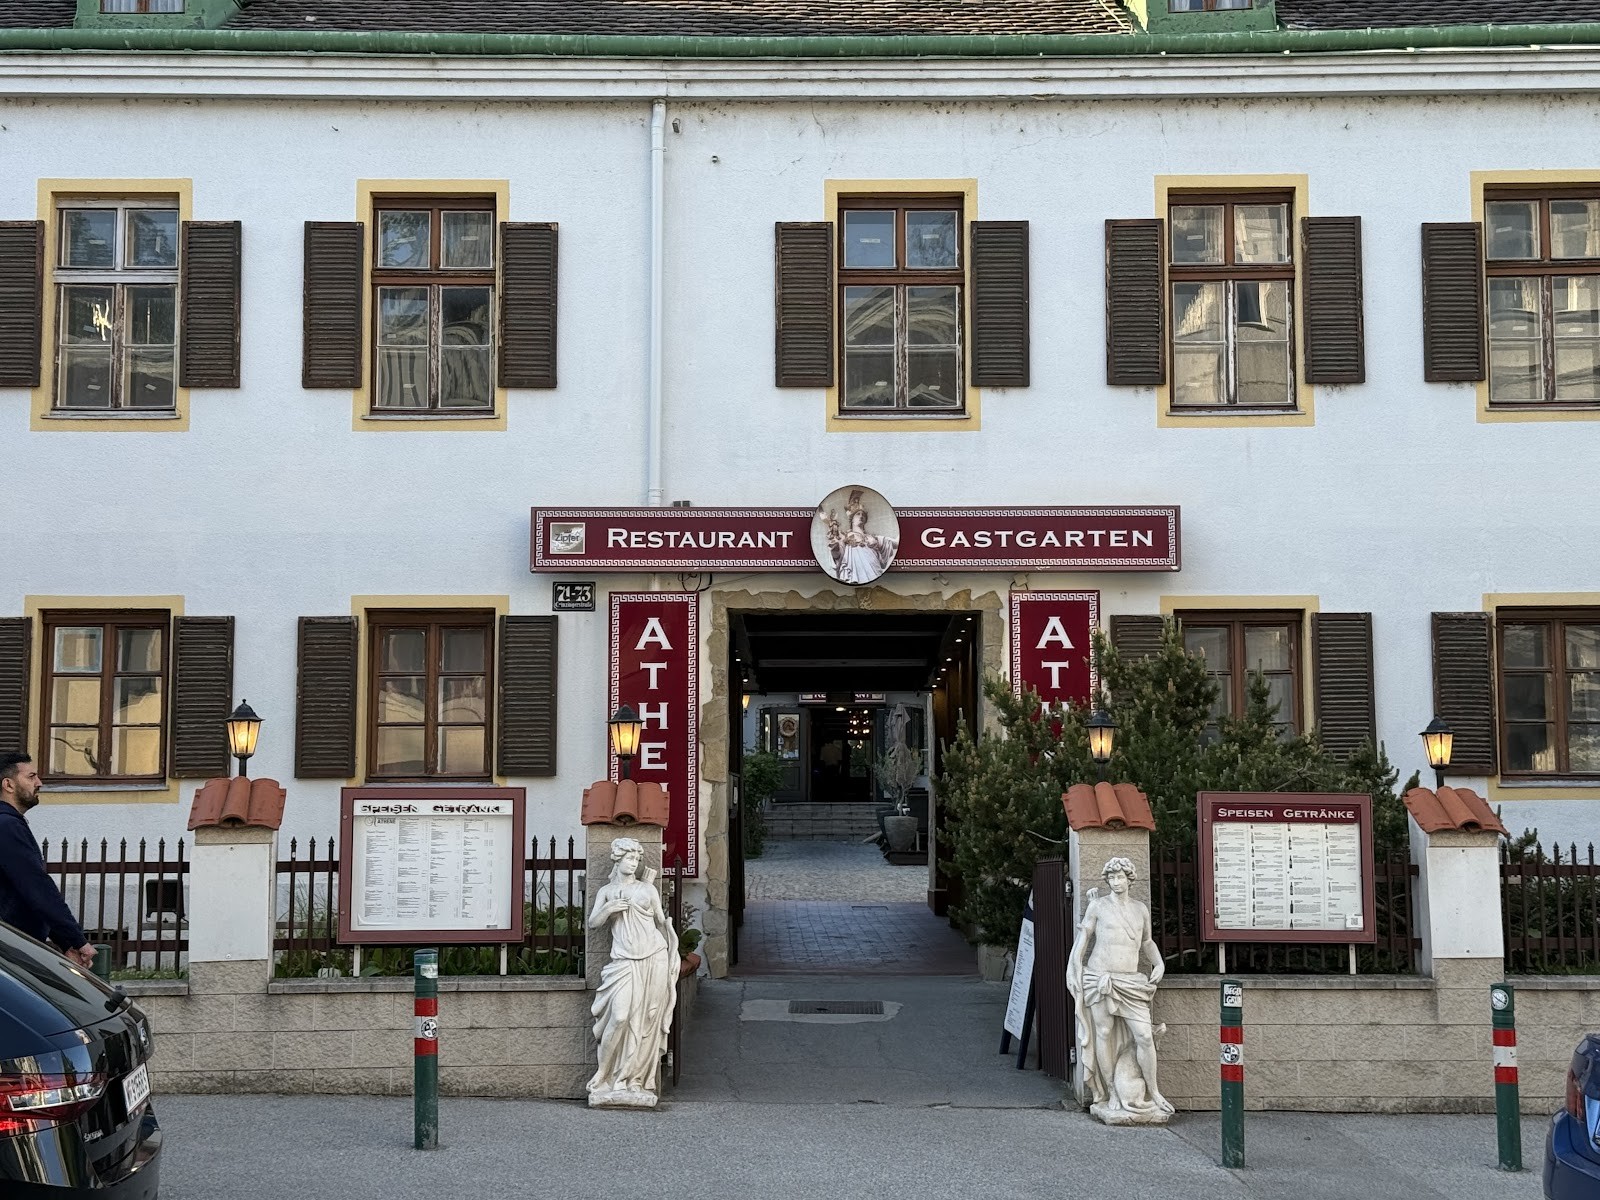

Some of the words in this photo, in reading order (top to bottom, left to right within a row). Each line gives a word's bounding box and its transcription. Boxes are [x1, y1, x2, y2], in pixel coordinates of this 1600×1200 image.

[554, 533, 580, 543] Zipfer
[606, 528, 794, 549] RESTAURANT
[920, 526, 1154, 549] GASTGARTEN
[557, 585, 592, 602] 71-73
[1217, 807, 1274, 818] SPEISEN
[1282, 808, 1355, 819] GETRÄNKE
